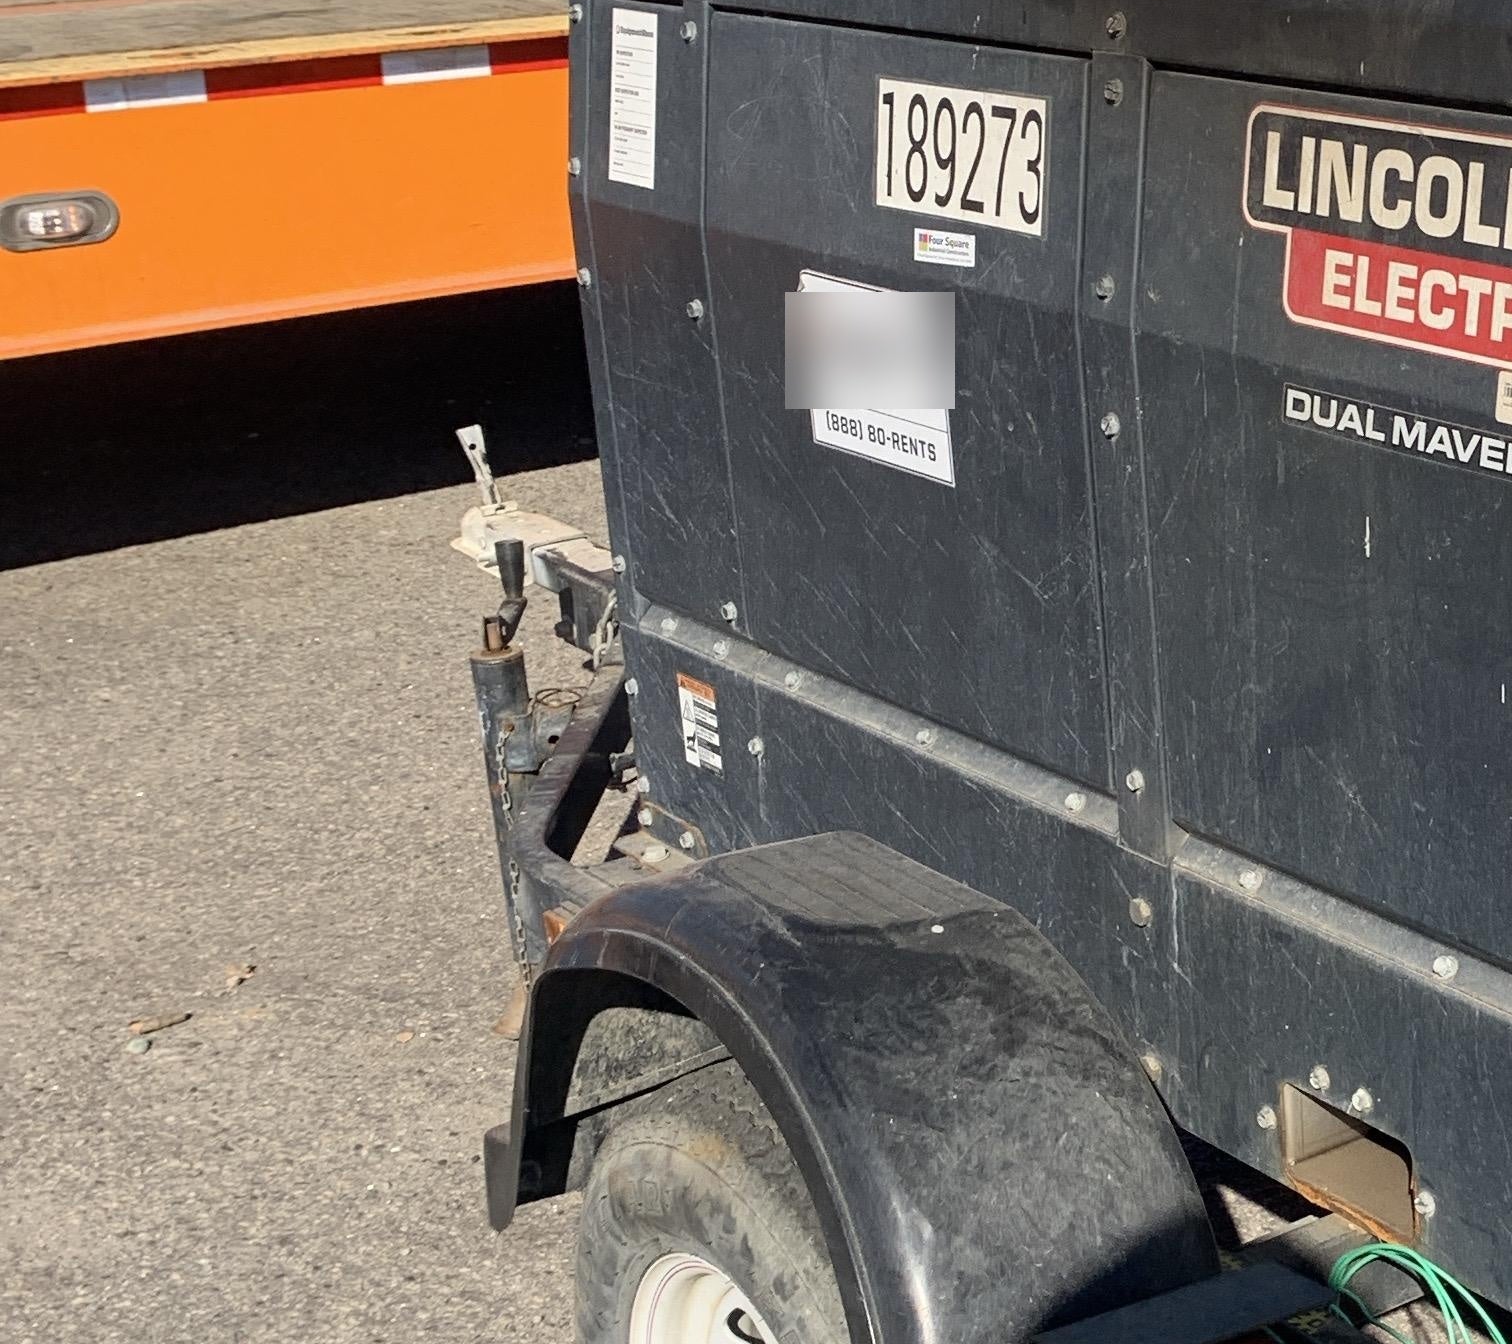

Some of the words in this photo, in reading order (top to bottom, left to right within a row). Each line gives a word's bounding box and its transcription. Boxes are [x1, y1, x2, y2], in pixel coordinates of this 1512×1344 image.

[881, 91, 1043, 226] 189273
[945, 236, 970, 249] Square
[825, 410, 864, 442] (888)
[867, 425, 937, 462] 80-RENTS
[1285, 388, 1385, 442] DUAL
